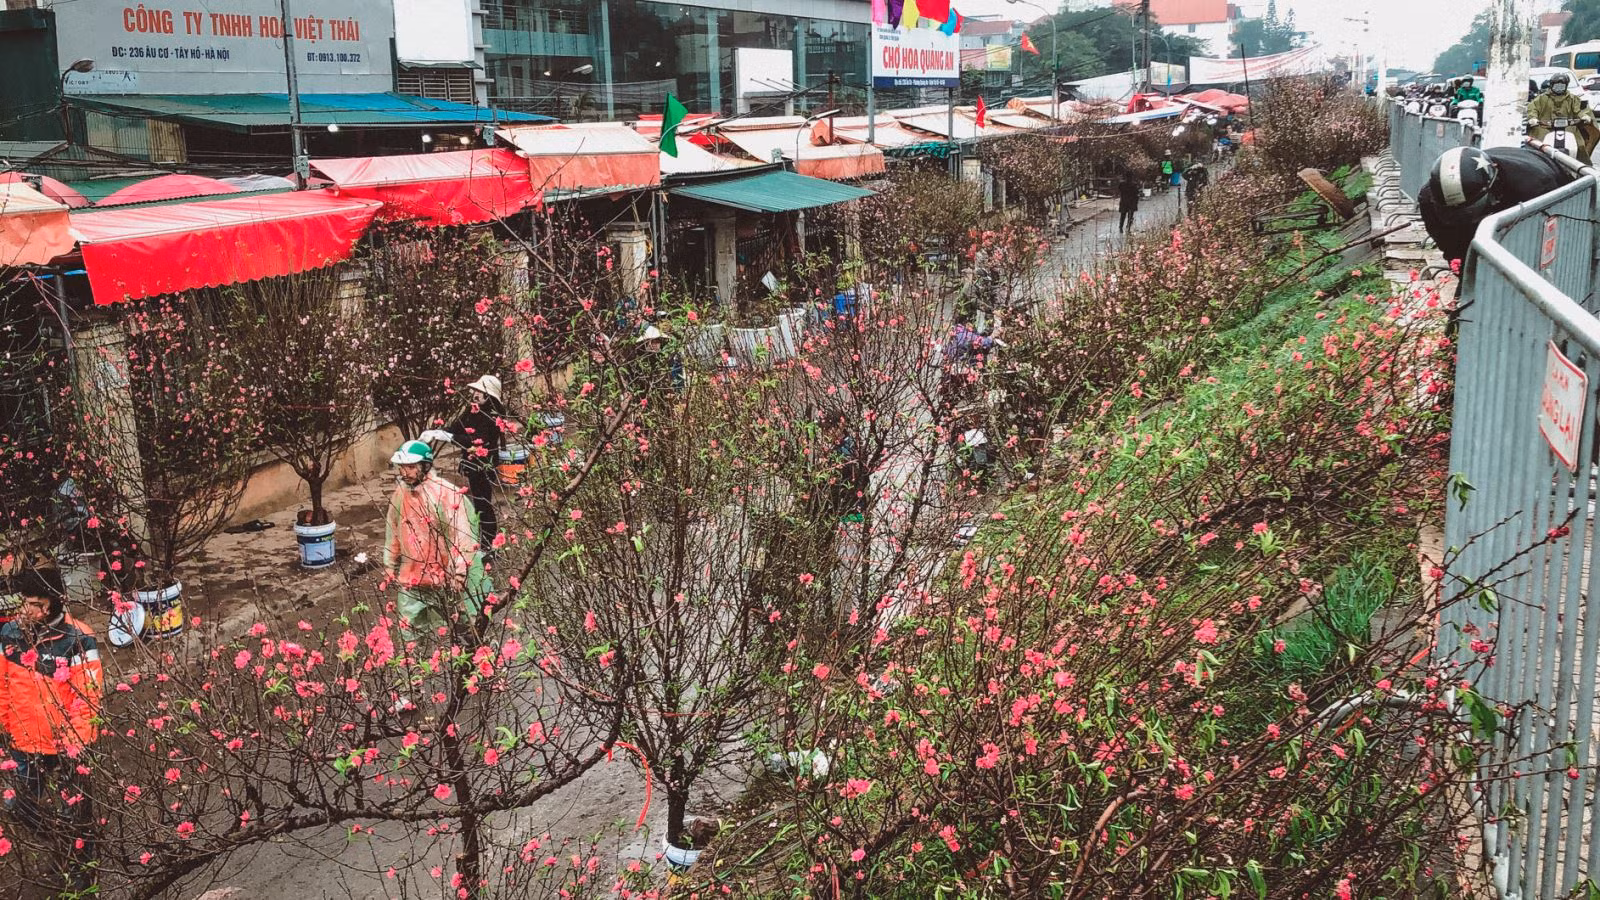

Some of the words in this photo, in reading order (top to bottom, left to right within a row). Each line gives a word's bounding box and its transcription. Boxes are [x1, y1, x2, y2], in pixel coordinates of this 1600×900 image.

[123, 4, 173, 34] CÔNG
[183, 11, 202, 35] TY
[209, 13, 252, 37] TNHH
[294, 15, 324, 44] VIỆT
[329, 17, 359, 41] THÁI
[112, 46, 127, 58] ĐC:
[129, 46, 144, 58] 236
[145, 45, 157, 58] ÂU
[158, 46, 169, 59] CƠ
[174, 46, 189, 59] TÂY
[217, 48, 230, 61] NỘI
[883, 44, 900, 75] CHỢ
[902, 47, 918, 69] HOA
[920, 41, 943, 74] QUẢNG
[945, 51, 954, 71] AN
